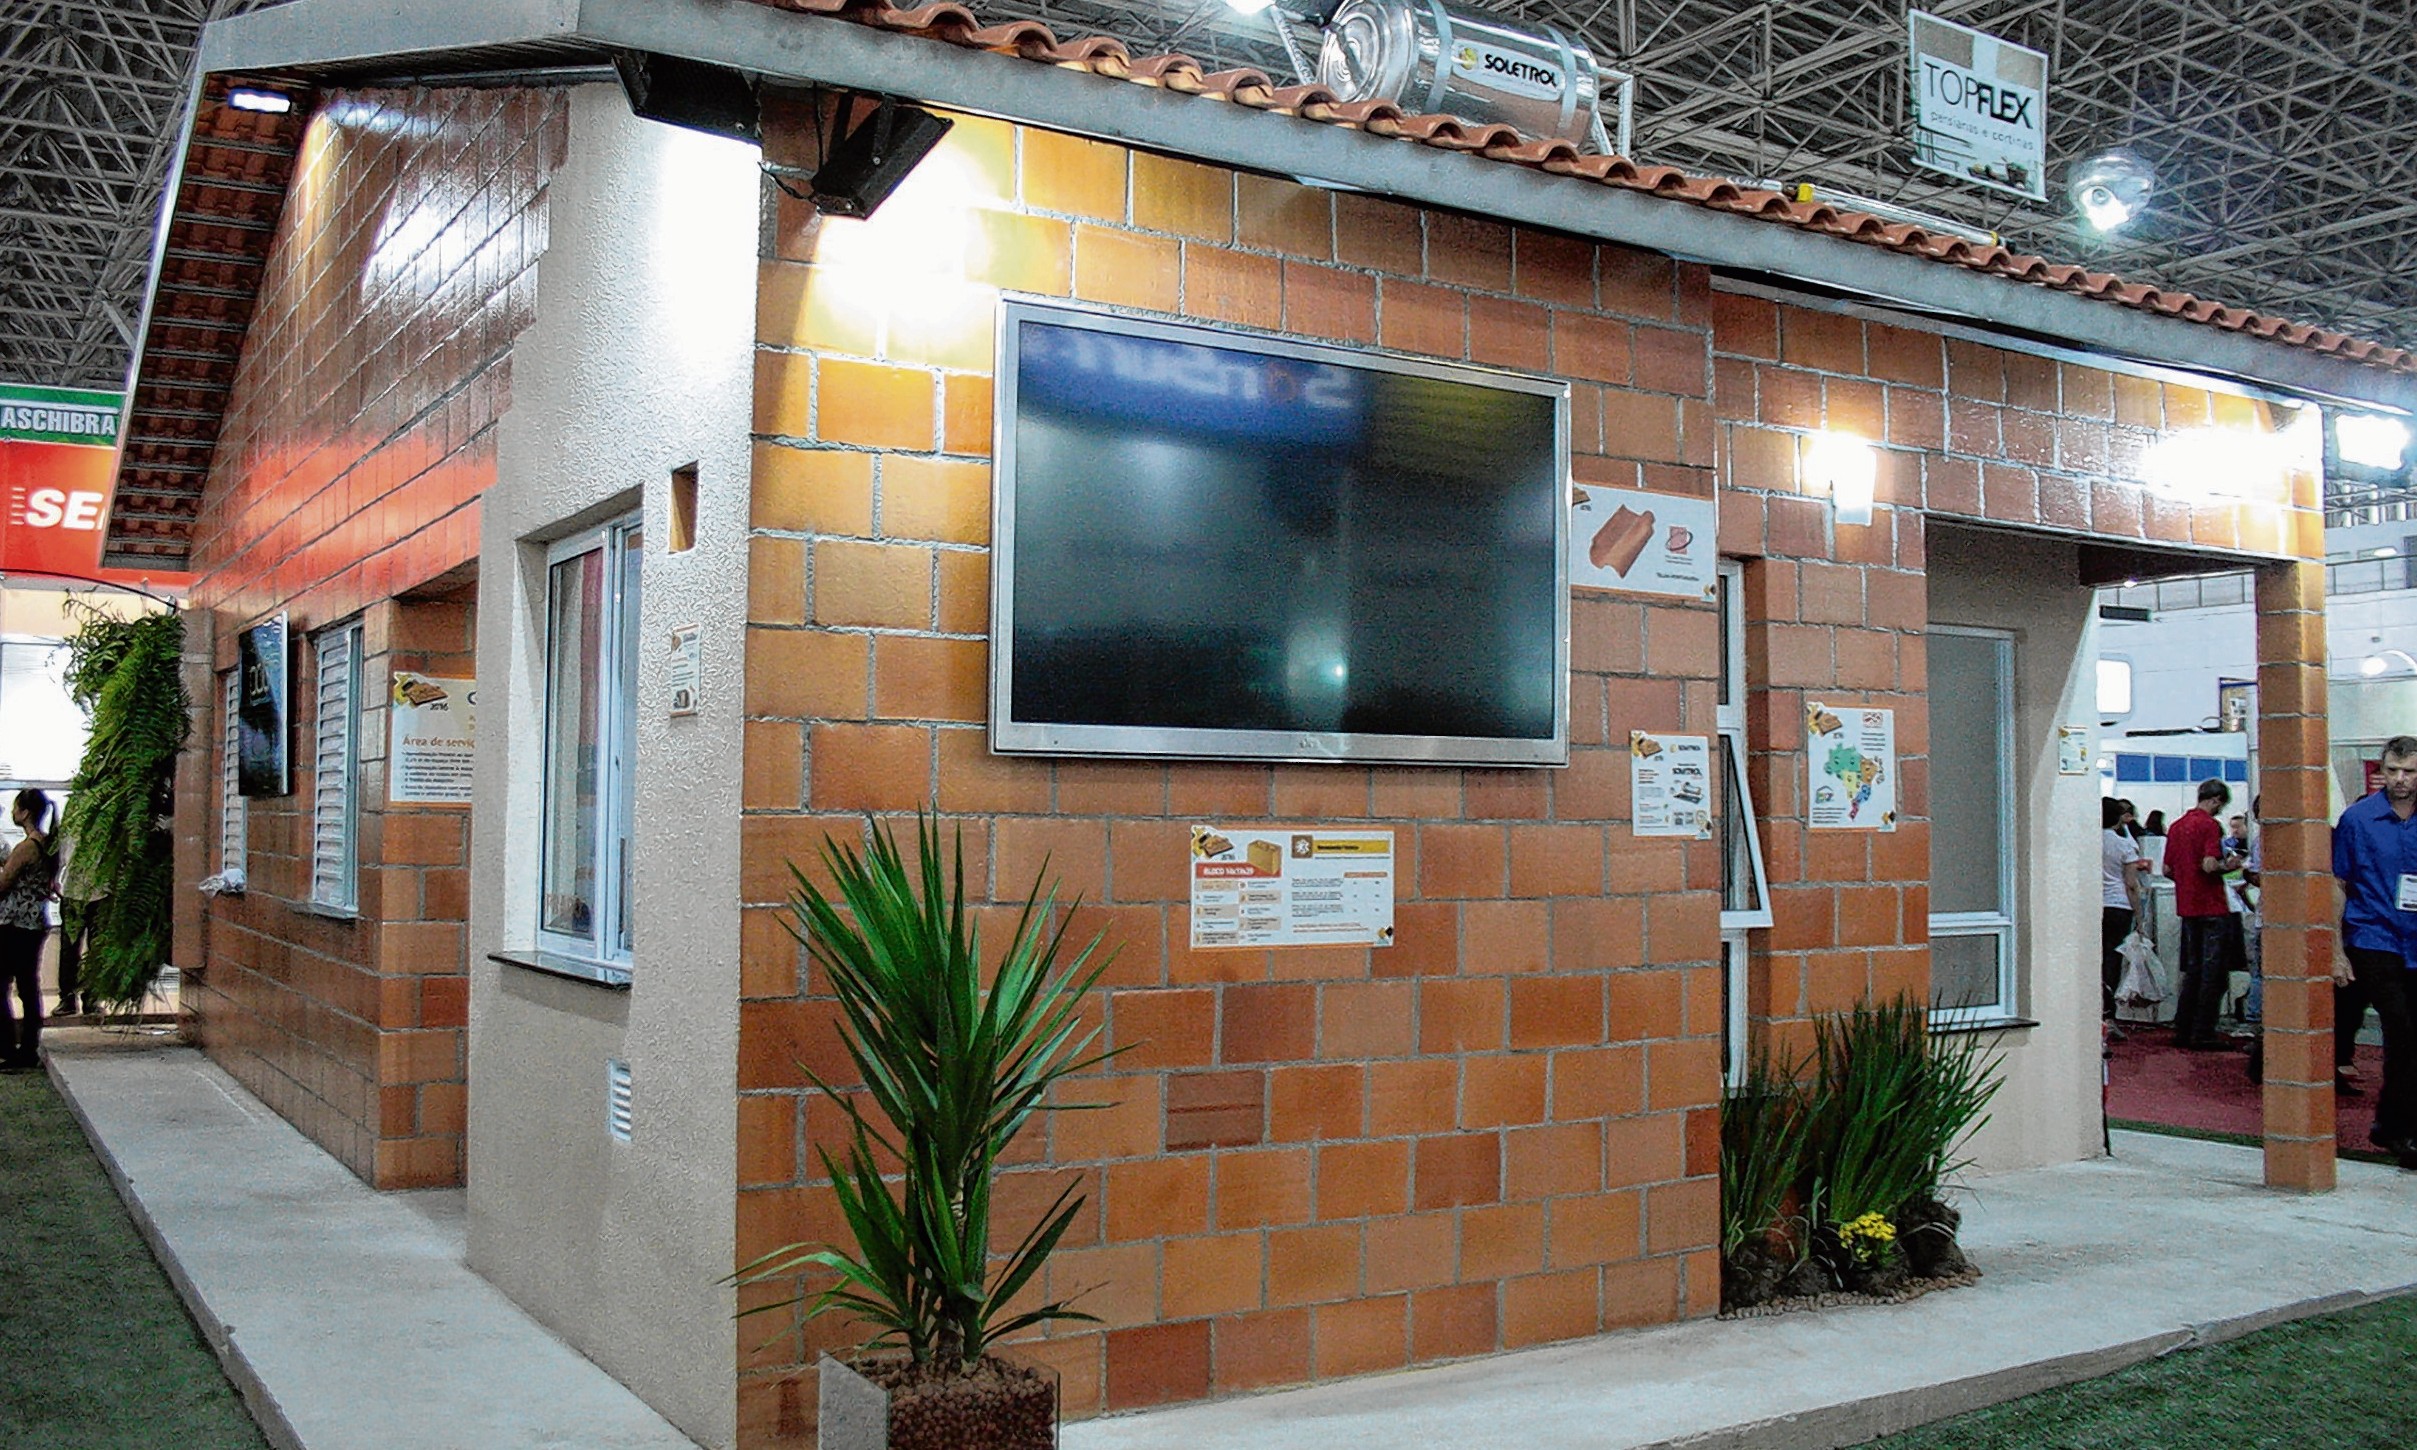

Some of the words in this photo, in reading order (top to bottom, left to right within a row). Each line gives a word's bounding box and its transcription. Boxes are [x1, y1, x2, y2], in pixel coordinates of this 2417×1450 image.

[1484, 53, 1557, 88] SOLETROL
[1924, 61, 2034, 130] TOPFLEX
[1, 406, 117, 436] ASCHIBRA
[26, 488, 106, 531] SE
